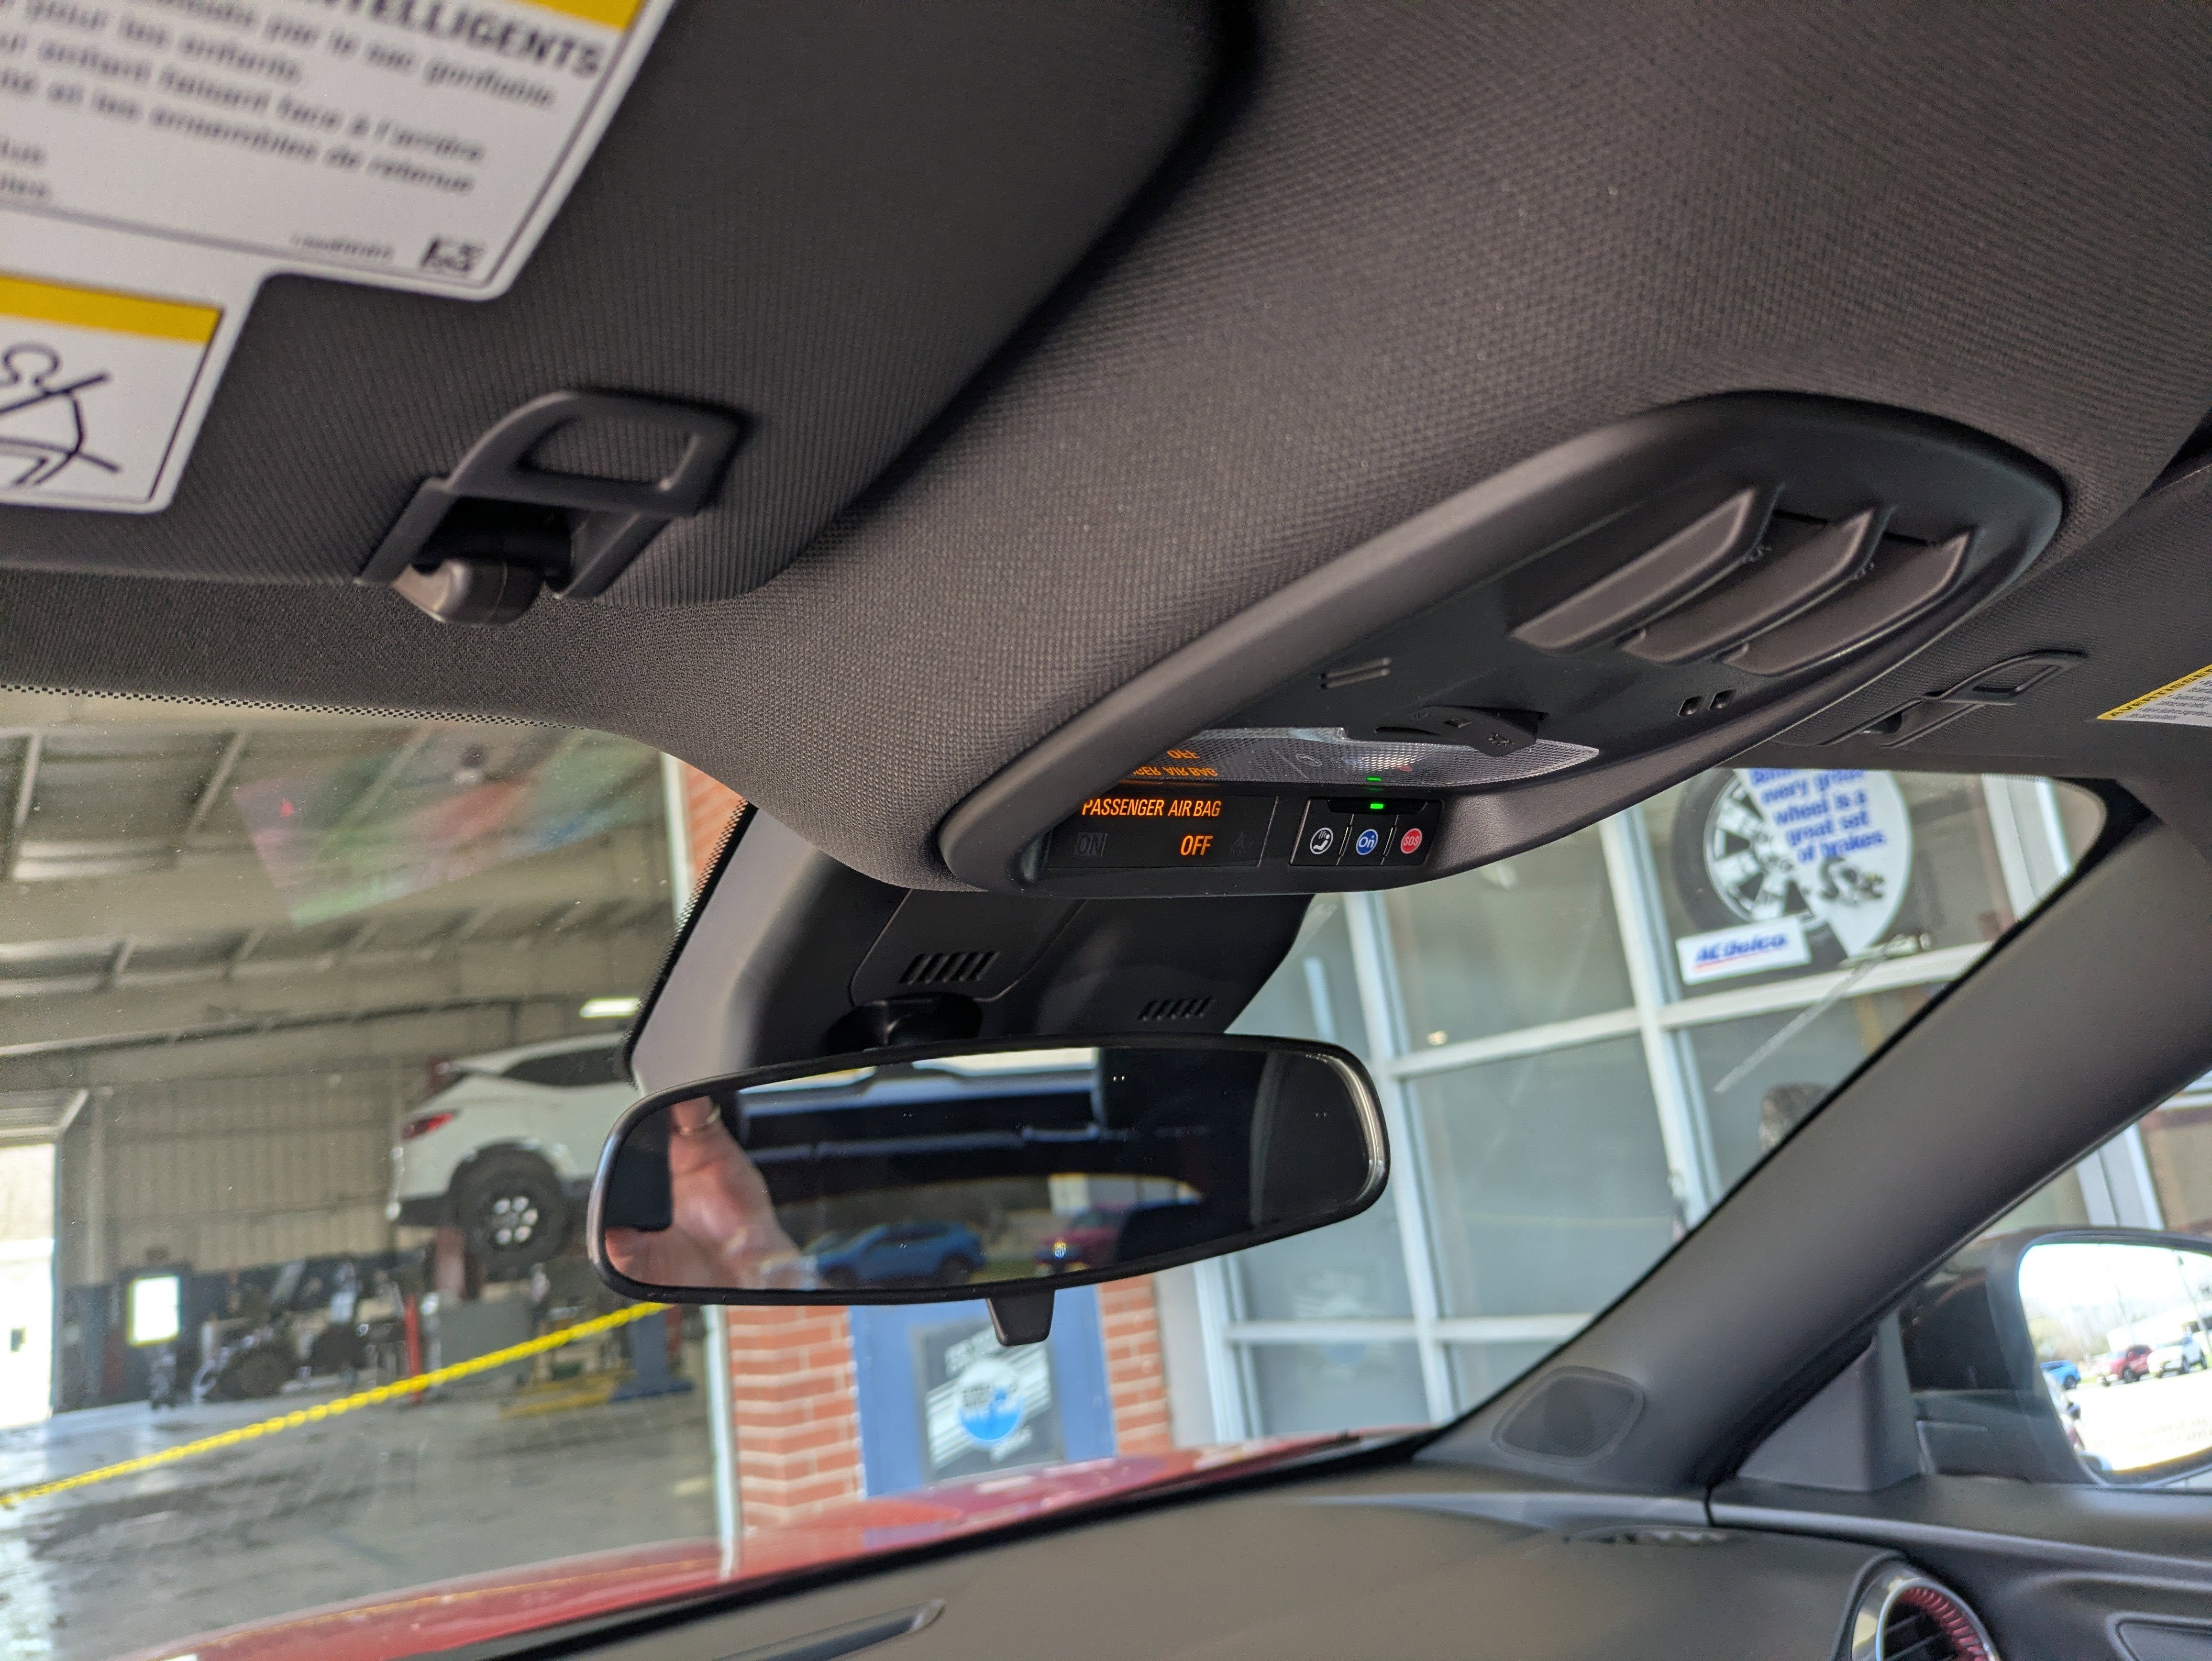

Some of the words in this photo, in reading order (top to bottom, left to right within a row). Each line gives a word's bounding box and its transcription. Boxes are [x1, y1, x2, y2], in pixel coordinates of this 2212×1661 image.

[1081, 798, 1165, 816] PASSENGER
[1167, 799, 1193, 817] AIR
[1193, 800, 1222, 817] BAG
[1775, 798, 1828, 824] wheel
[1358, 836, 1375, 848] On
[1403, 836, 1420, 846] SOS
[1786, 819, 1834, 847] great
[1180, 835, 1214, 856] OFF
